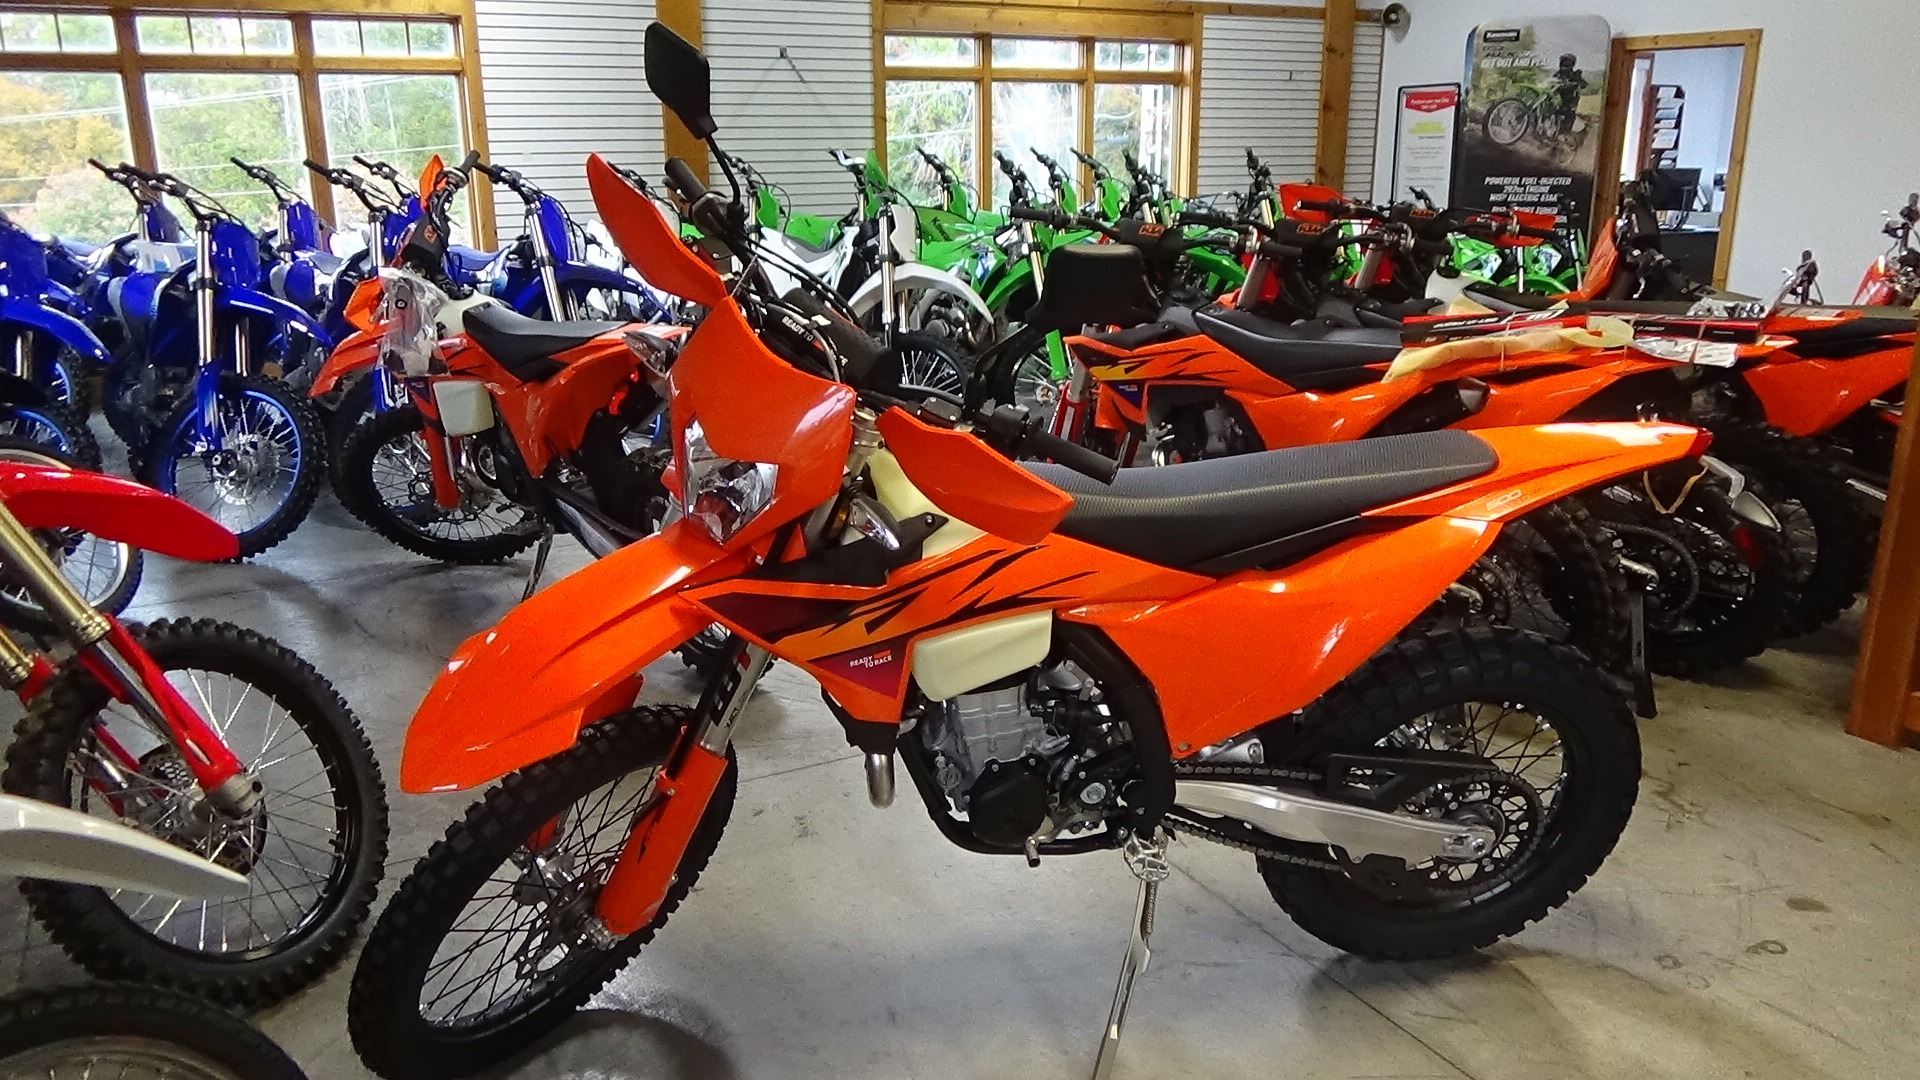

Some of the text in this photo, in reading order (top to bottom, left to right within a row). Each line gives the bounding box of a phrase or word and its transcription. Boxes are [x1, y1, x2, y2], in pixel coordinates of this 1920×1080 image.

[781, 315, 814, 342] READY TO
[849, 655, 873, 668] READY
[864, 654, 893, 669] TO RACE
